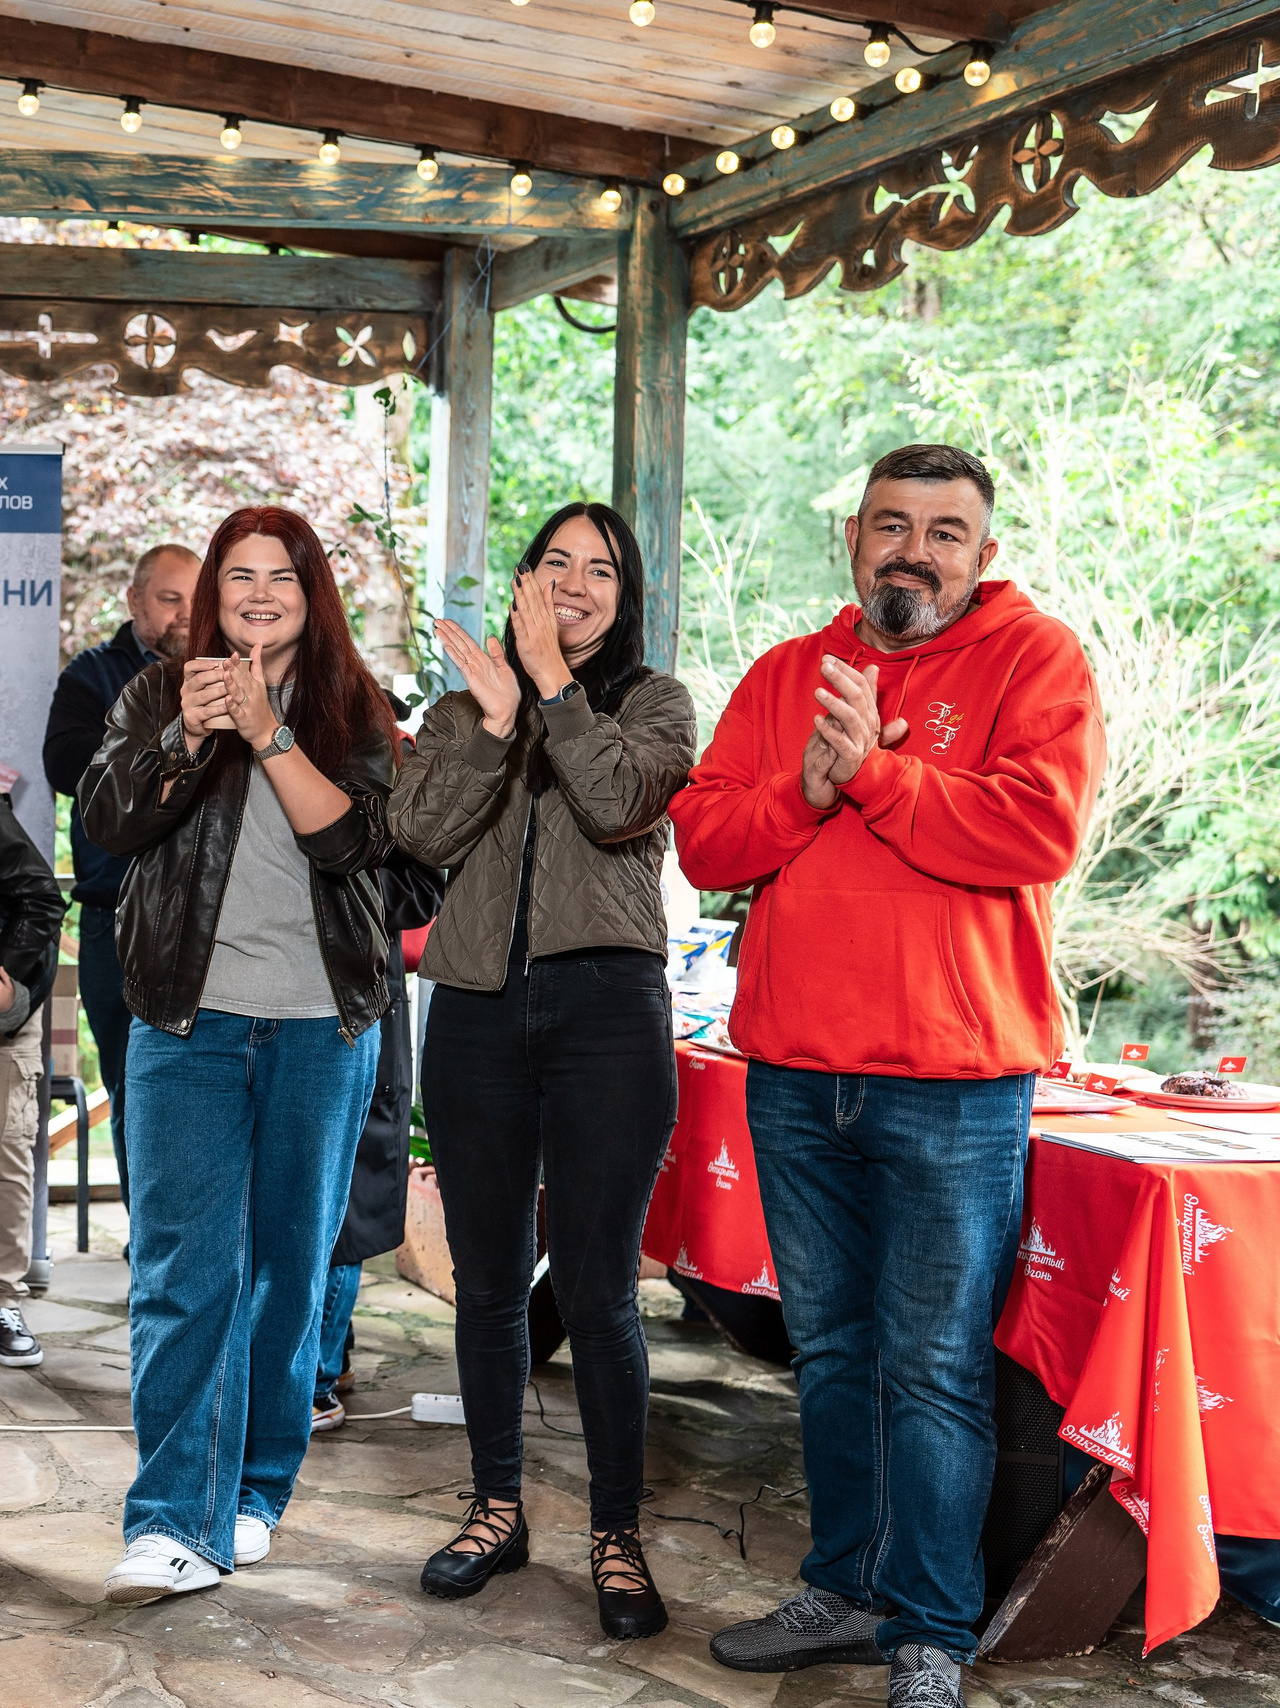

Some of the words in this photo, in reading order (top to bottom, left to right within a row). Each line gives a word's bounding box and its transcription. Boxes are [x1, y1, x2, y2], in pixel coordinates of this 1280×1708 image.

[1182, 1193, 1199, 1276] Открытый
[1017, 1250, 1065, 1271] ткрытый
[1024, 1263, 1052, 1281] Огонь
